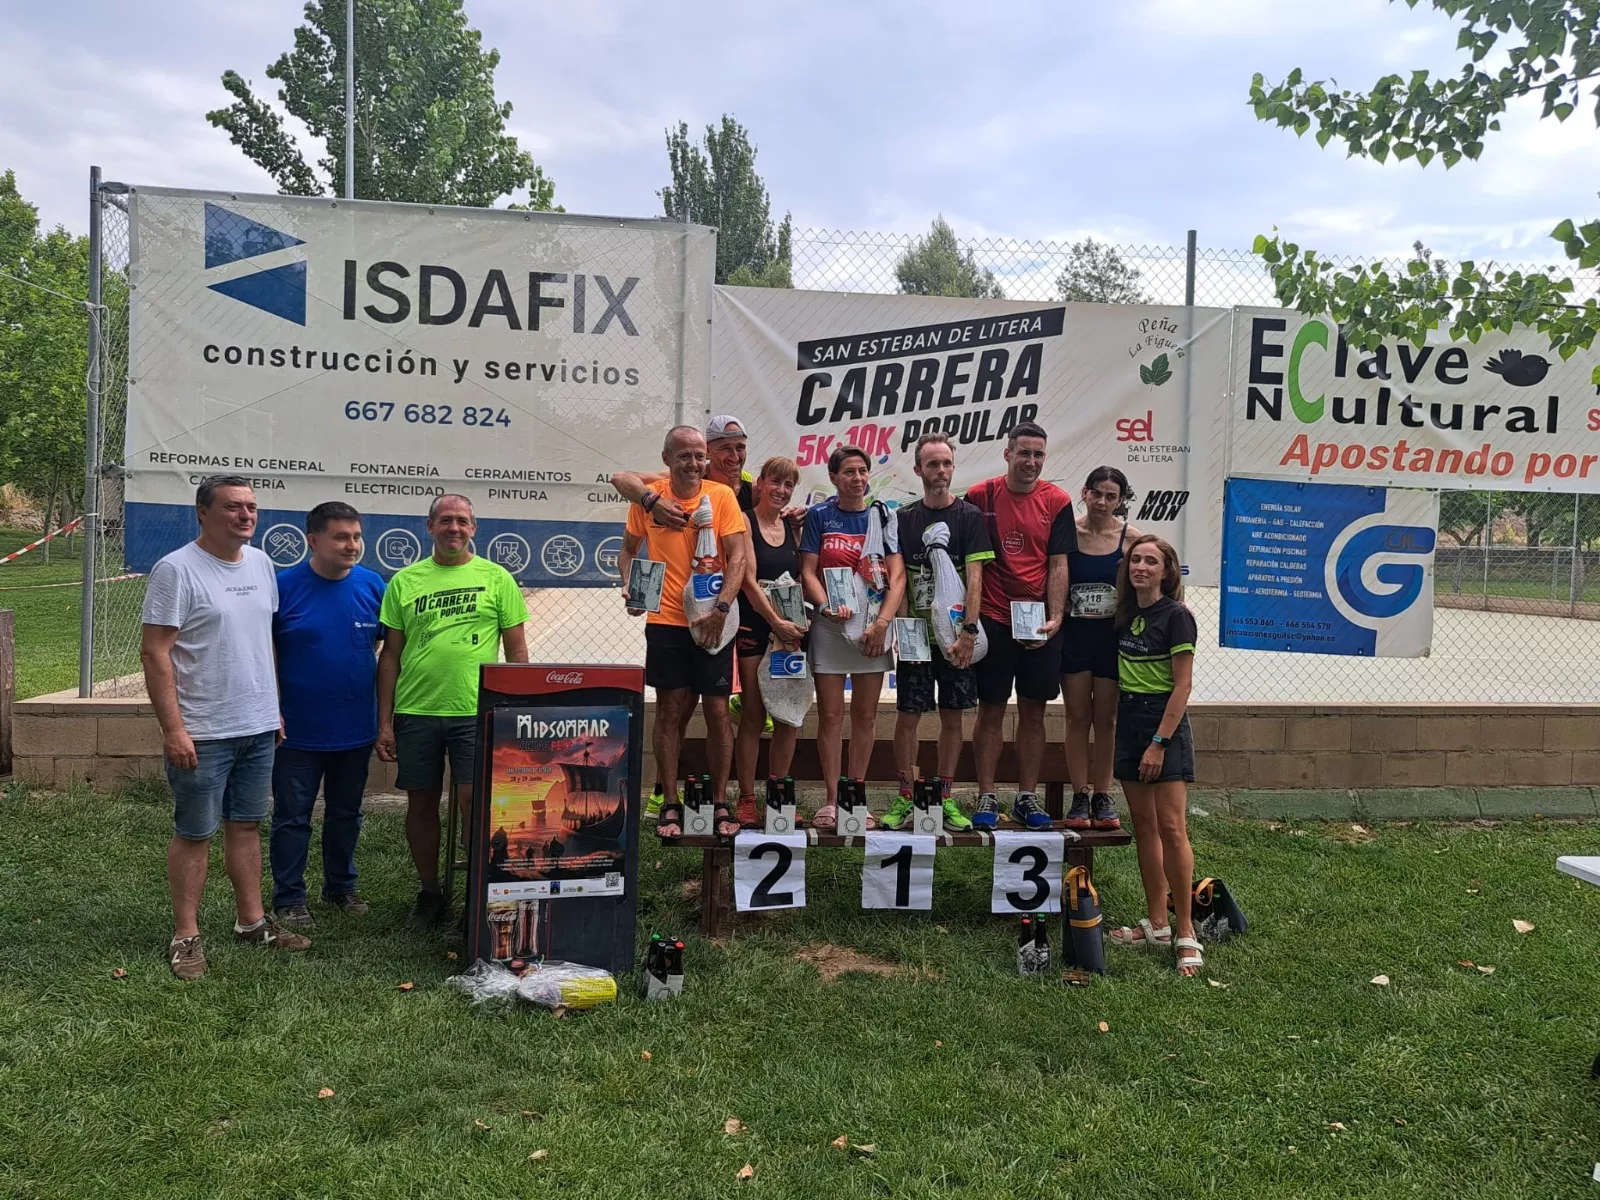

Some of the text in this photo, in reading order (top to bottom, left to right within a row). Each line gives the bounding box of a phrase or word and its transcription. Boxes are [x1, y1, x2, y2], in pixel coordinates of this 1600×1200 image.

[342, 259, 640, 337] ISDAFIX
[1138, 317, 1178, 334] Peña
[812, 316, 1042, 363] SAN ESTEBAN DE LITERA
[1128, 335, 1186, 359] La Figuera
[203, 343, 640, 387] construcción y servicios
[796, 343, 1044, 426] CARRERA
[344, 401, 512, 428] 667 682 824
[1116, 410, 1154, 442] sel
[1128, 445, 1191, 454] SAN ESTEBAN
[150, 452, 325, 472] REFORMAS EN GENERAL
[1279, 433, 1598, 483] Apostando por
[350, 463, 440, 477] FONTANERÍA
[464, 468, 572, 482] CERRAMIENTOS
[344, 483, 444, 497] ELECTRICIDAD
[488, 488, 548, 501] PINTURA
[587, 492, 630, 503] CLIMA
[1144, 490, 1190, 506] MOTO
[1136, 504, 1182, 521] MON
[1260, 503, 1301, 513] ENERGÍA SOLAR
[1235, 515, 1267, 525] FONTANERÍA
[1289, 519, 1324, 529] CALEFACCIÓN
[1251, 531, 1307, 541] AIRE ACONDICIONADO
[1248, 545, 1307, 556] DEPURACIÓN PISCINAS
[1245, 558, 1307, 570] REPARACIÓN CALDERAS
[1247, 573, 1275, 582] APARATOS
[1280, 575, 1303, 584] PRESIÓN
[1086, 595, 1102, 603] 118
[1254, 587, 1288, 597] AEROTERMIA
[1293, 590, 1323, 599] GEOTERMIA
[429, 593, 477, 610] CARRERA
[440, 603, 477, 618] POPULAR
[748, 841, 794, 908] 2
[880, 845, 913, 907] 1
[1005, 845, 1050, 911] 3
